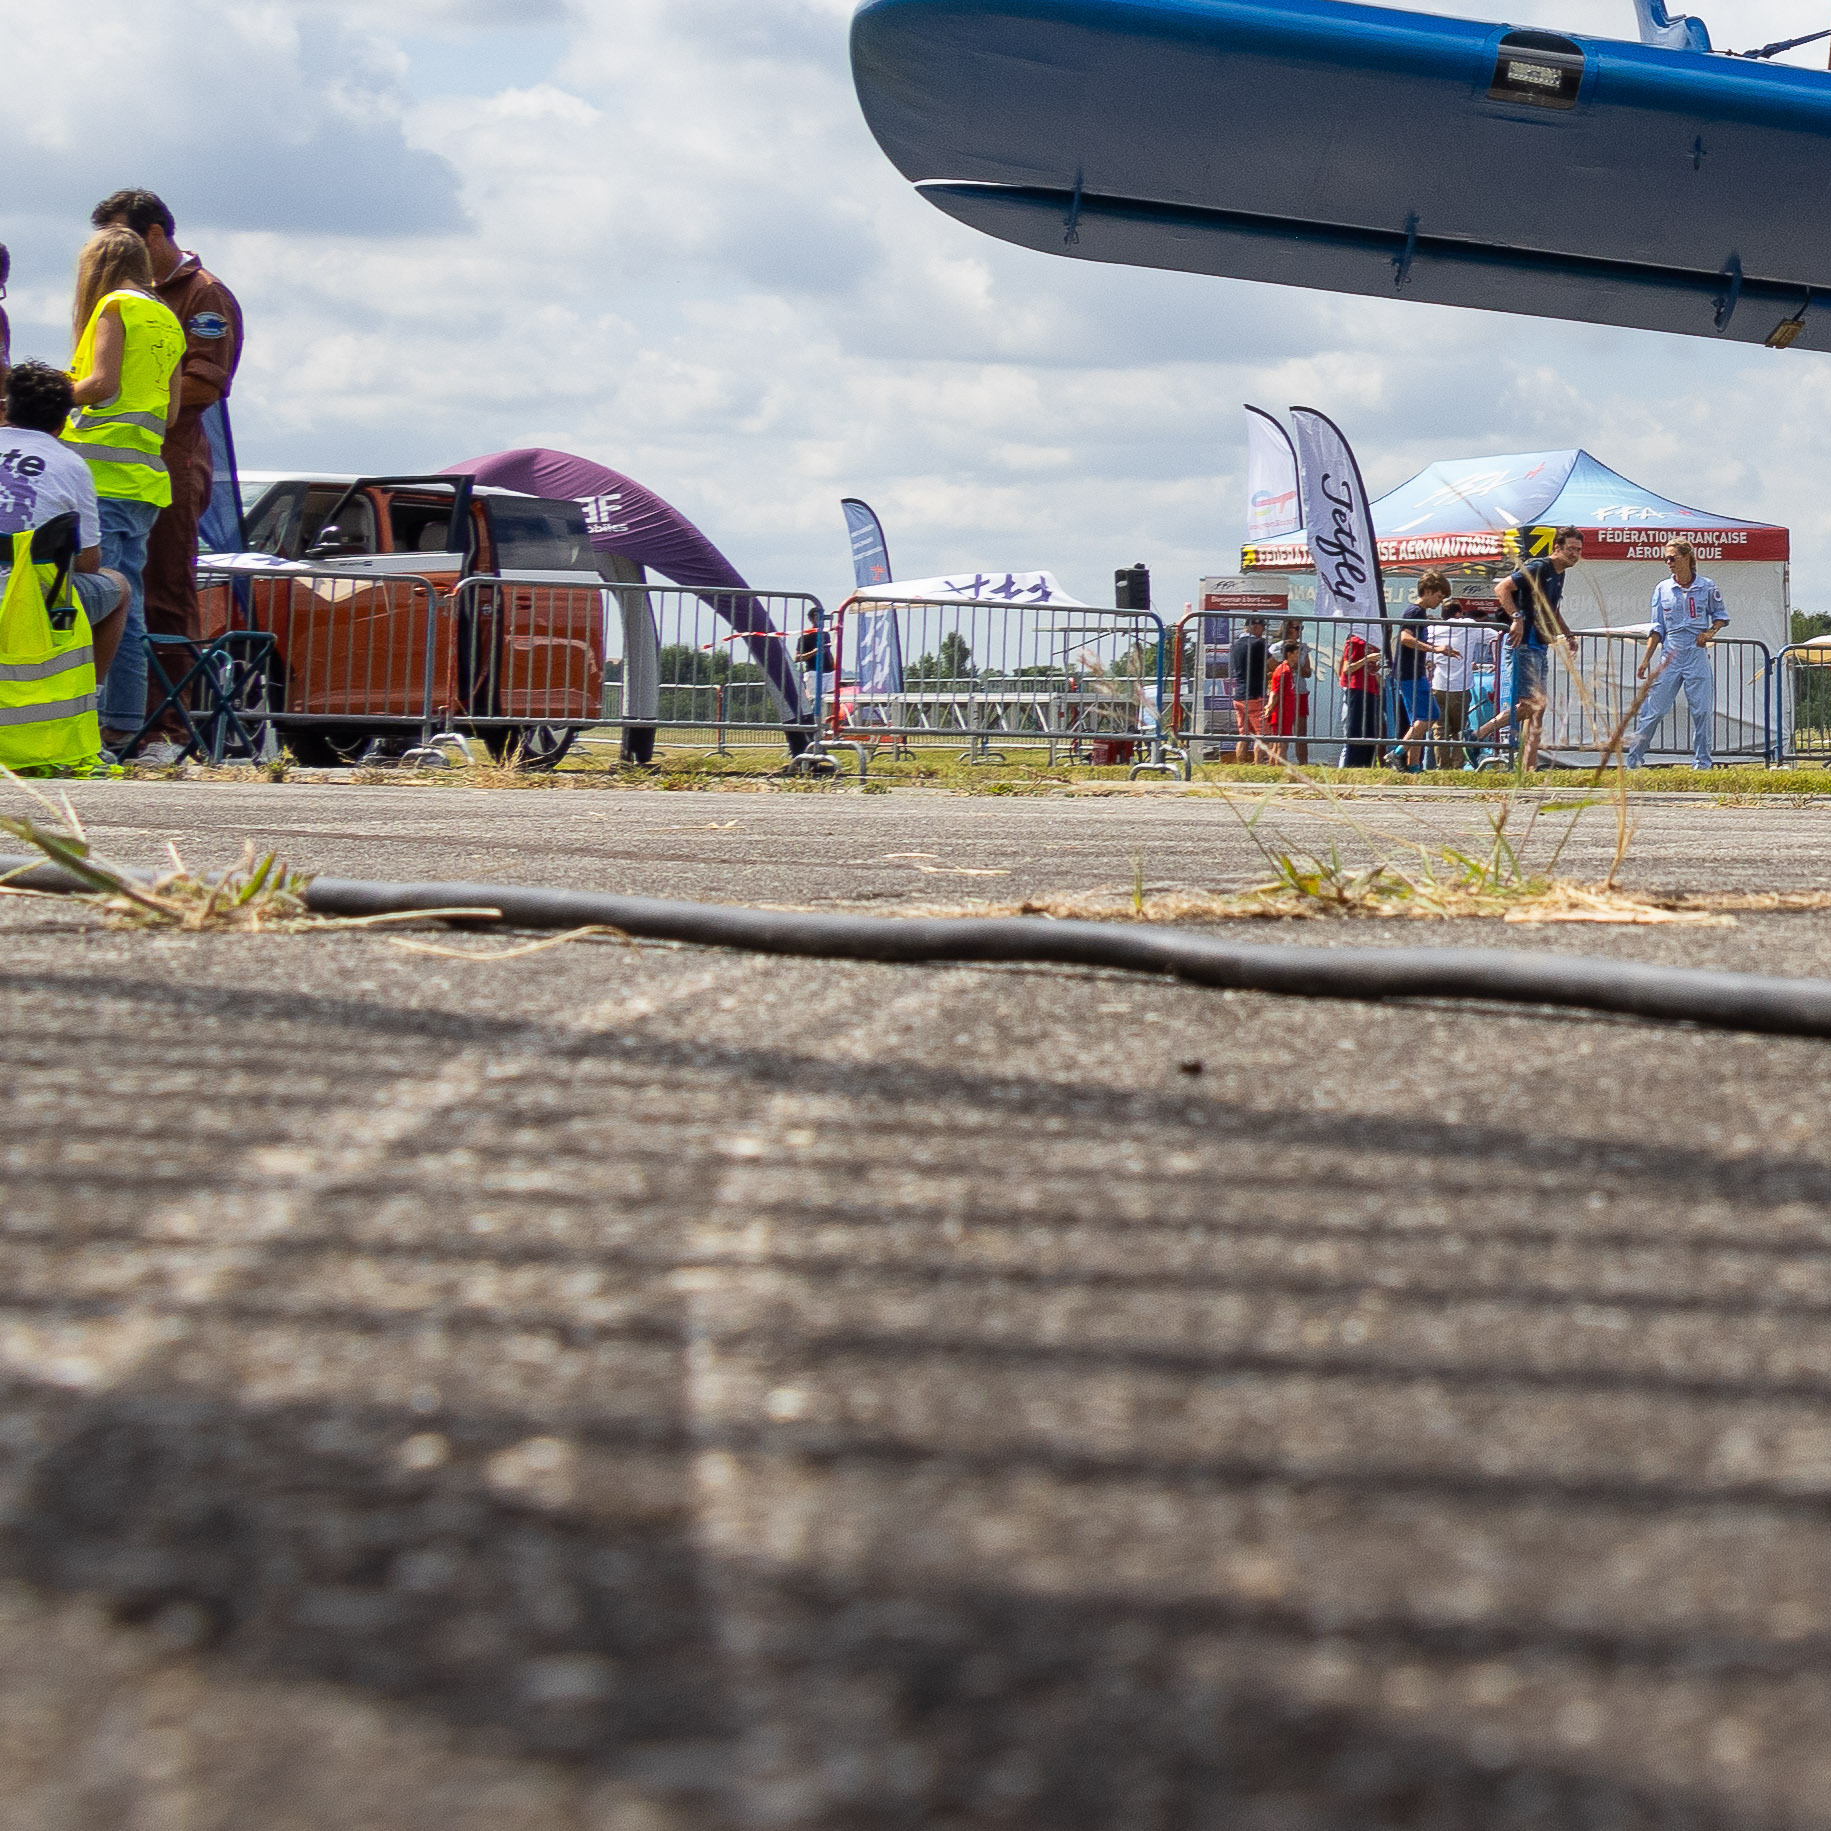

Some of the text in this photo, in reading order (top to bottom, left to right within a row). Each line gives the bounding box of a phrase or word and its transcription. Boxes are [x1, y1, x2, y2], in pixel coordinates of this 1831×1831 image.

[0, 449, 46, 477] te
[1315, 472, 1366, 604] Jetfly
[1598, 527, 1748, 546] FÉDÉRATION FRANÇAISE
